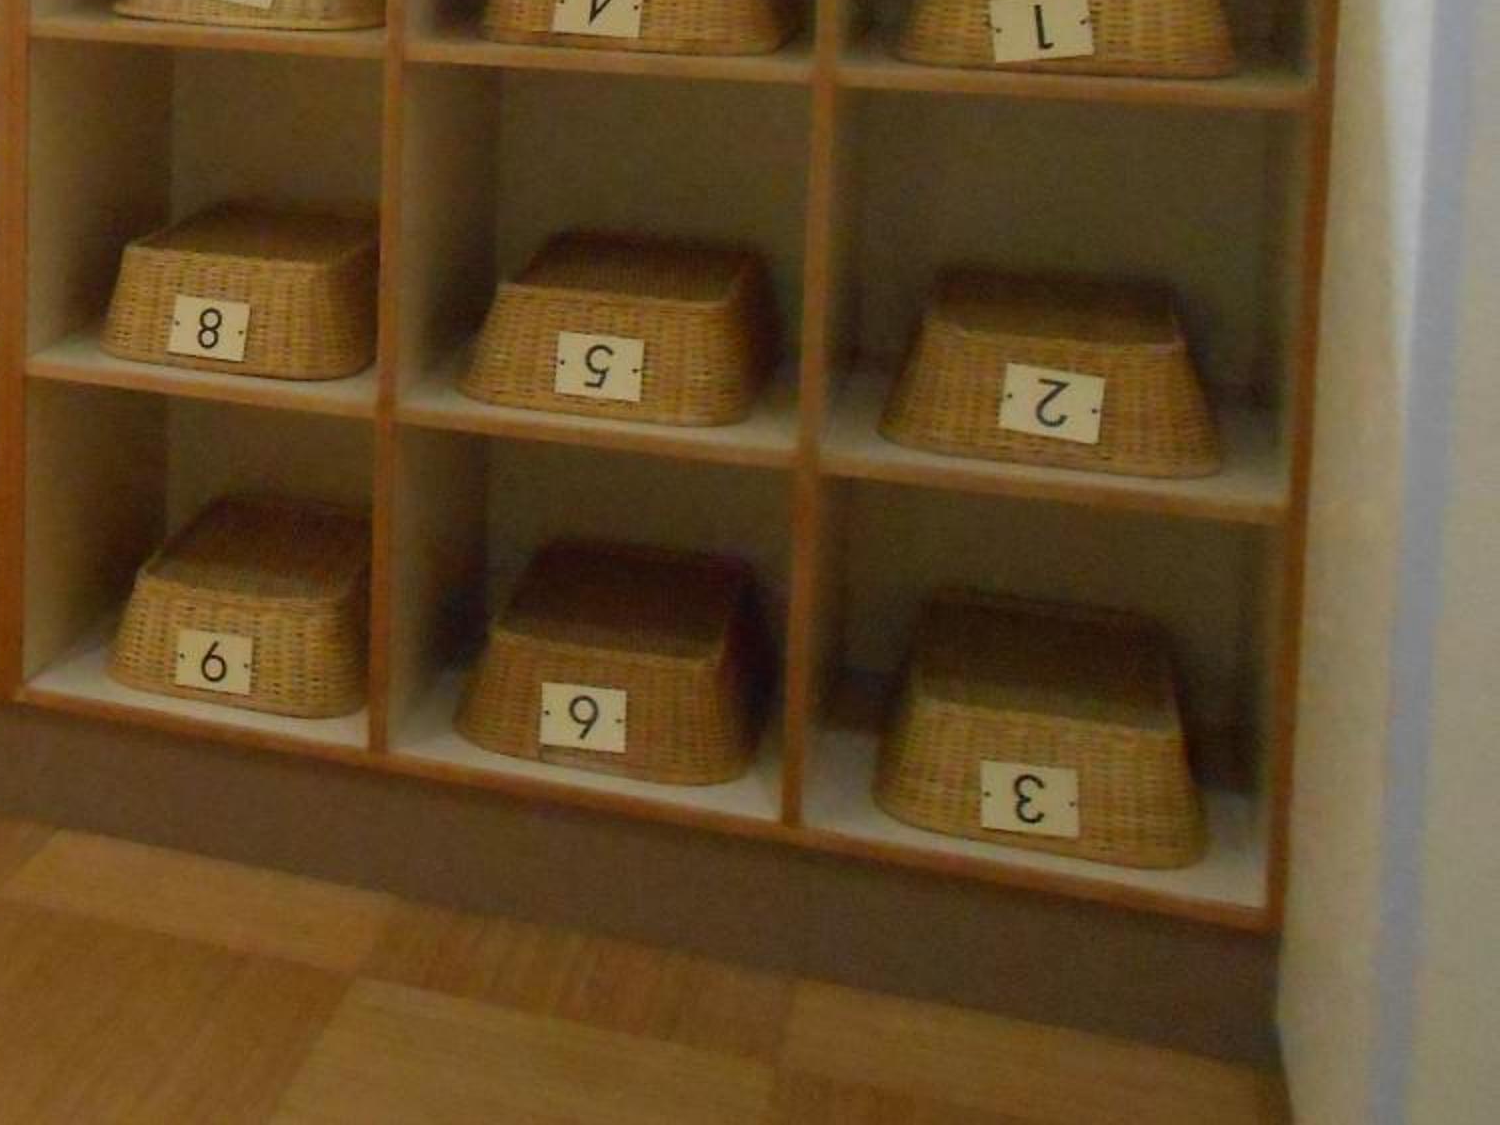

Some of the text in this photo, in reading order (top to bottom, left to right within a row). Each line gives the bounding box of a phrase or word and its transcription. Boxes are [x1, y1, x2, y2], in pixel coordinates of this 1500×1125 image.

[1034, 5, 1054, 49] 1
[197, 308, 222, 349] 8
[584, 344, 614, 389] 5
[1035, 378, 1070, 427] 2
[201, 641, 226, 682] 9
[569, 695, 598, 739] 6
[1014, 774, 1044, 823] 3
